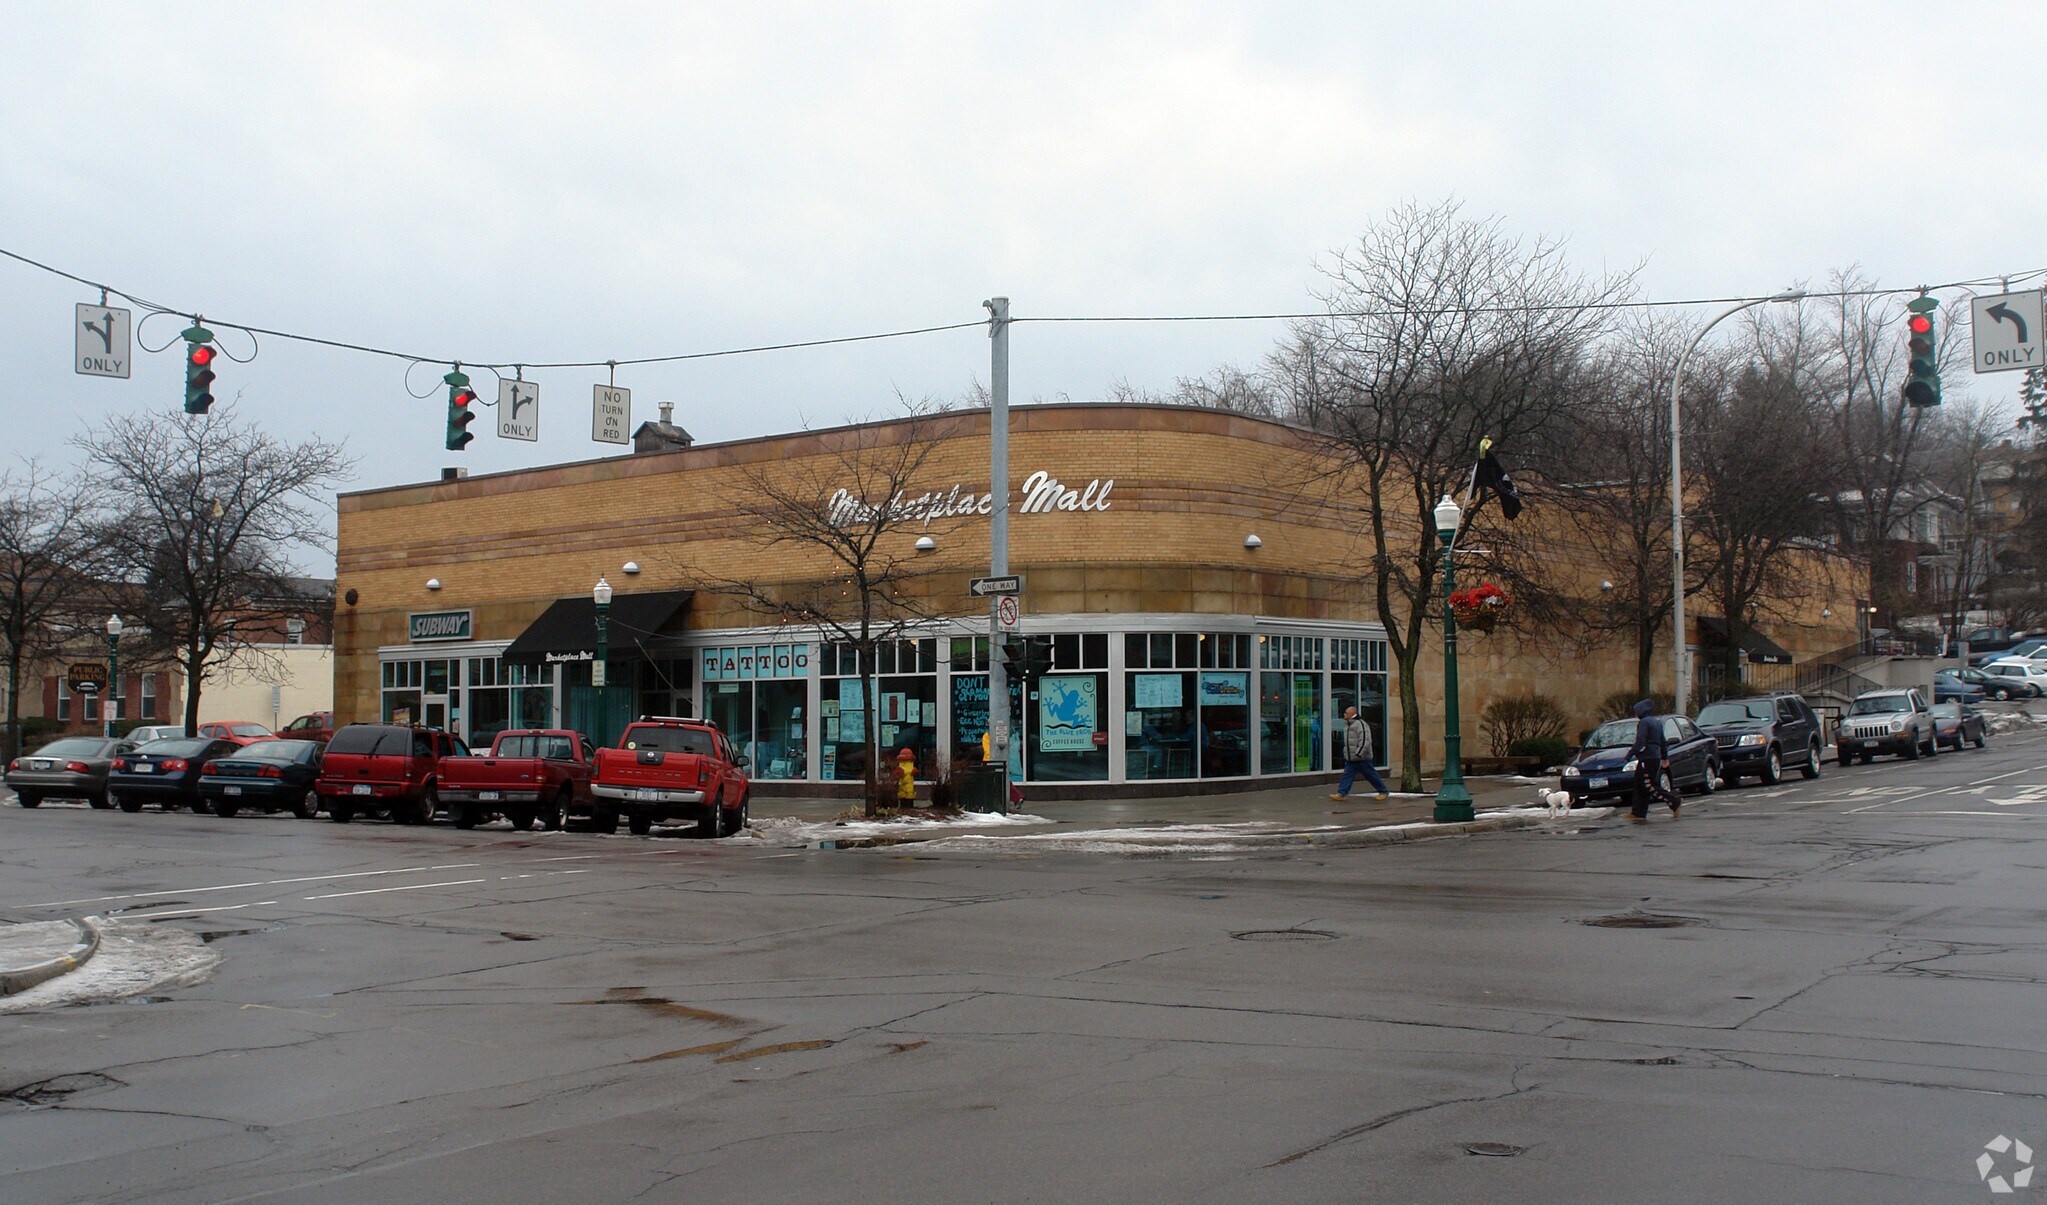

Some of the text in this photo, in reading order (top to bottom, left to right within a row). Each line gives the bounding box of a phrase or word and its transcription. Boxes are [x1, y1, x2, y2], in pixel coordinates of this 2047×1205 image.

[1984, 347, 2035, 365] ONLY
[83, 357, 122, 372] ONLY
[604, 391, 621, 403] NO
[602, 404, 623, 415] TURN
[605, 416, 618, 427] ON
[503, 423, 532, 437] ONLY
[603, 429, 620, 439] RED
[828, 470, 1115, 527] Marketplac Mall
[981, 581, 1015, 591] ONE WAY
[412, 614, 469, 637] SUBWAY
[706, 654, 809, 671] TATTOO
